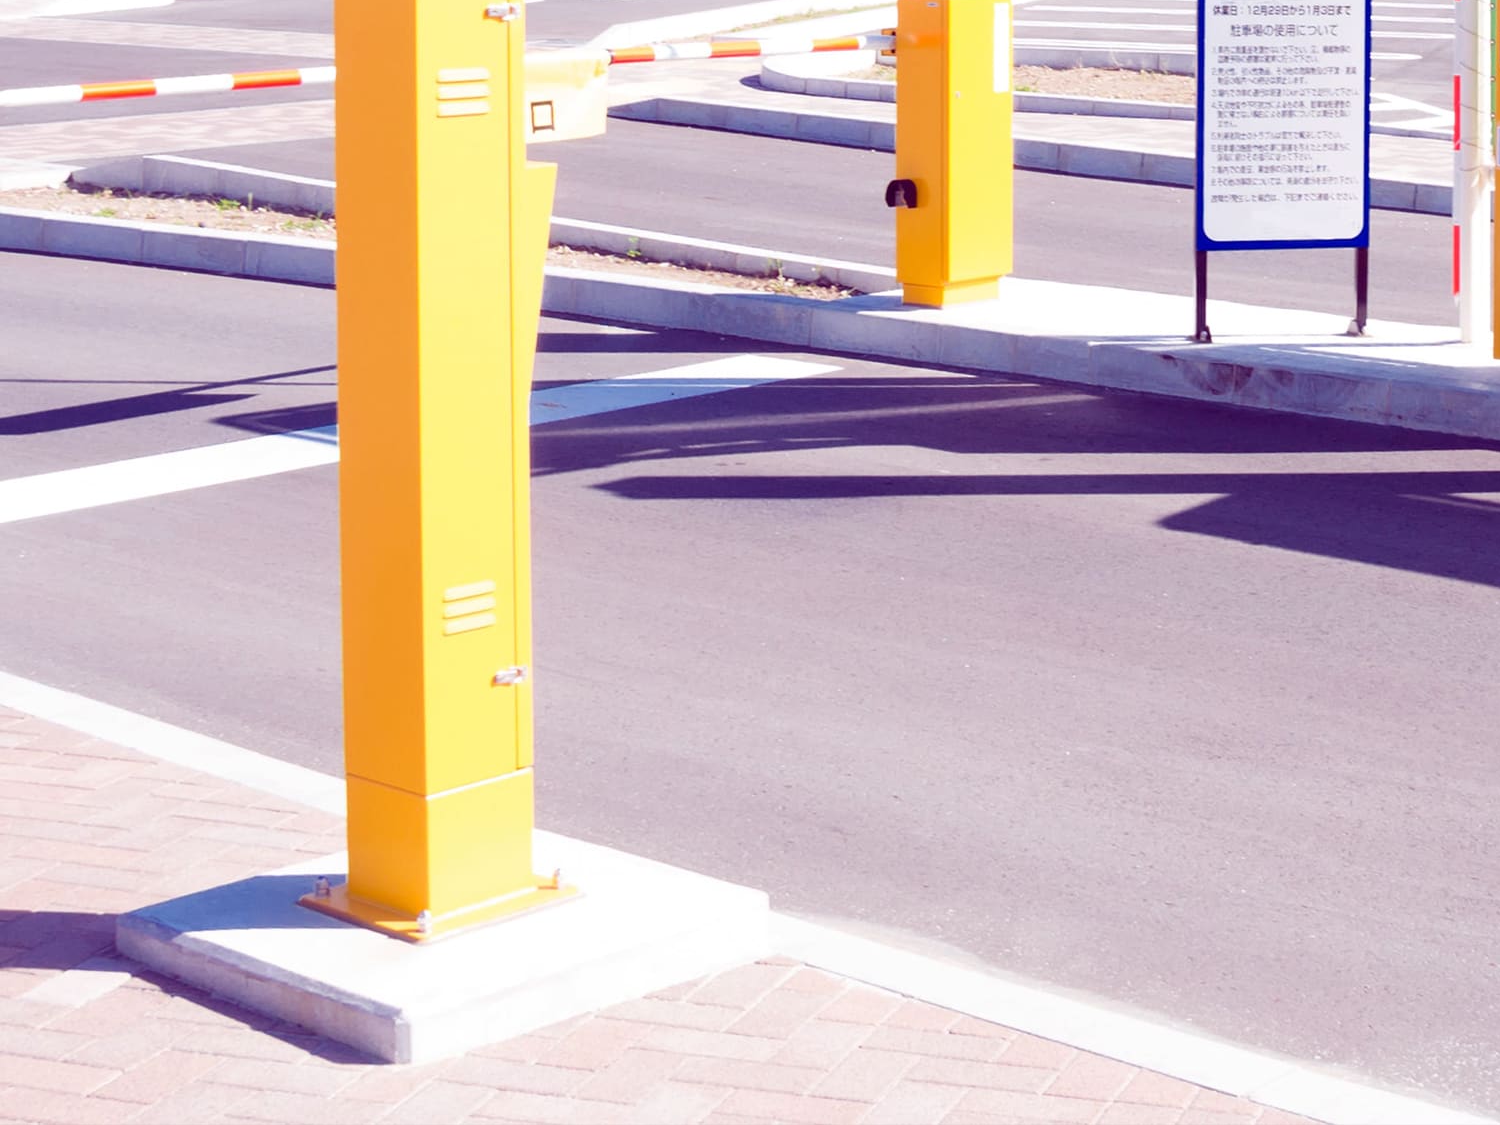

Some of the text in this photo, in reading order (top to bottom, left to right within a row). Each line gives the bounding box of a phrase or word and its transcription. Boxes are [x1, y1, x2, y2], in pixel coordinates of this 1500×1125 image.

[1229, 23, 1338, 37] 駐車場の使用について
